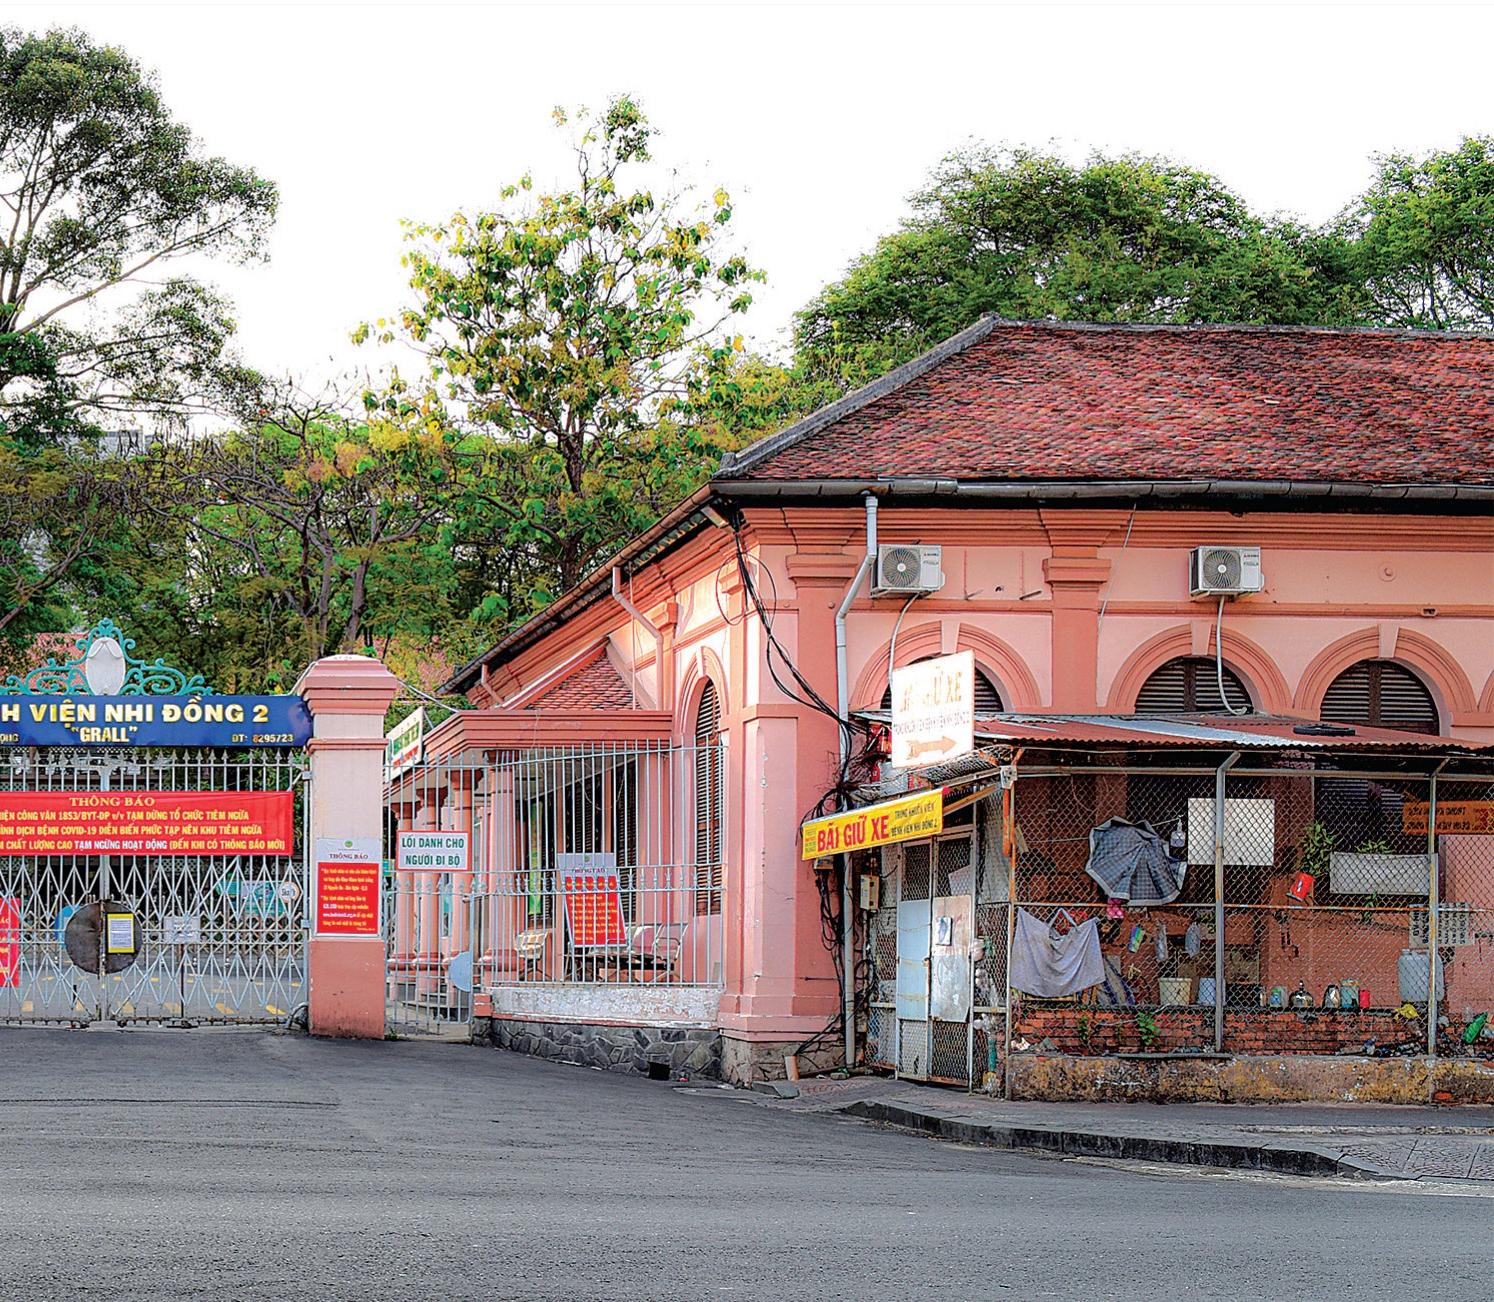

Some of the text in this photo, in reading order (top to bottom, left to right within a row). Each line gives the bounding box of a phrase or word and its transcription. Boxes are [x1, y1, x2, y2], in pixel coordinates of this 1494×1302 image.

[29, 698, 96, 729] VIỆN
[104, 704, 154, 723] NHI
[162, 696, 244, 723] ĐỒNG
[252, 704, 269, 723] 2
[232, 733, 294, 744] ĐT: 8295723
[69, 794, 155, 807] THÔNG BÁO
[17, 809, 38, 821] CÔNG
[40, 809, 56, 821] VĂN
[126, 811, 143, 822] TẠM
[146, 810, 168, 821] DỪNG
[169, 807, 181, 821] TỔ
[182, 810, 204, 821] CHỨC
[206, 809, 225, 821] TIÊM
[227, 810, 249, 821] NGỪA
[16, 826, 35, 837] DỊCH
[37, 824, 58, 837] BỆNH
[61, 826, 97, 835] COVID-19
[98, 822, 118, 835] DIỄN
[119, 823, 139, 835] BIẾN
[141, 825, 162, 835] PHỨC
[164, 826, 180, 837] TẠP
[182, 824, 198, 835] NÊN
[200, 826, 217, 835] KHU
[219, 824, 239, 835] TIÊM
[241, 825, 262, 835] NGỪA
[817, 822, 840, 853] BÃI
[843, 815, 867, 848] GIỮ
[870, 815, 890, 843] XE
[6, 837, 28, 850] CHẤT
[29, 840, 55, 851] LƯỢNG
[57, 840, 73, 850] CAO
[74, 840, 92, 851] TẠM
[94, 838, 120, 850] NGỪNG
[122, 840, 143, 851] HOẠT
[146, 838, 168, 851] ĐỘNG
[191, 840, 205, 850] KHI
[207, 838, 218, 850] CÓ
[220, 838, 247, 850] THÔNG
[248, 838, 265, 850] BÁO
[401, 833, 465, 850] LỐI DÀNH CHO
[354, 852, 369, 860] BÁO
[405, 852, 461, 868] NGƯỜI ĐI BỘ
